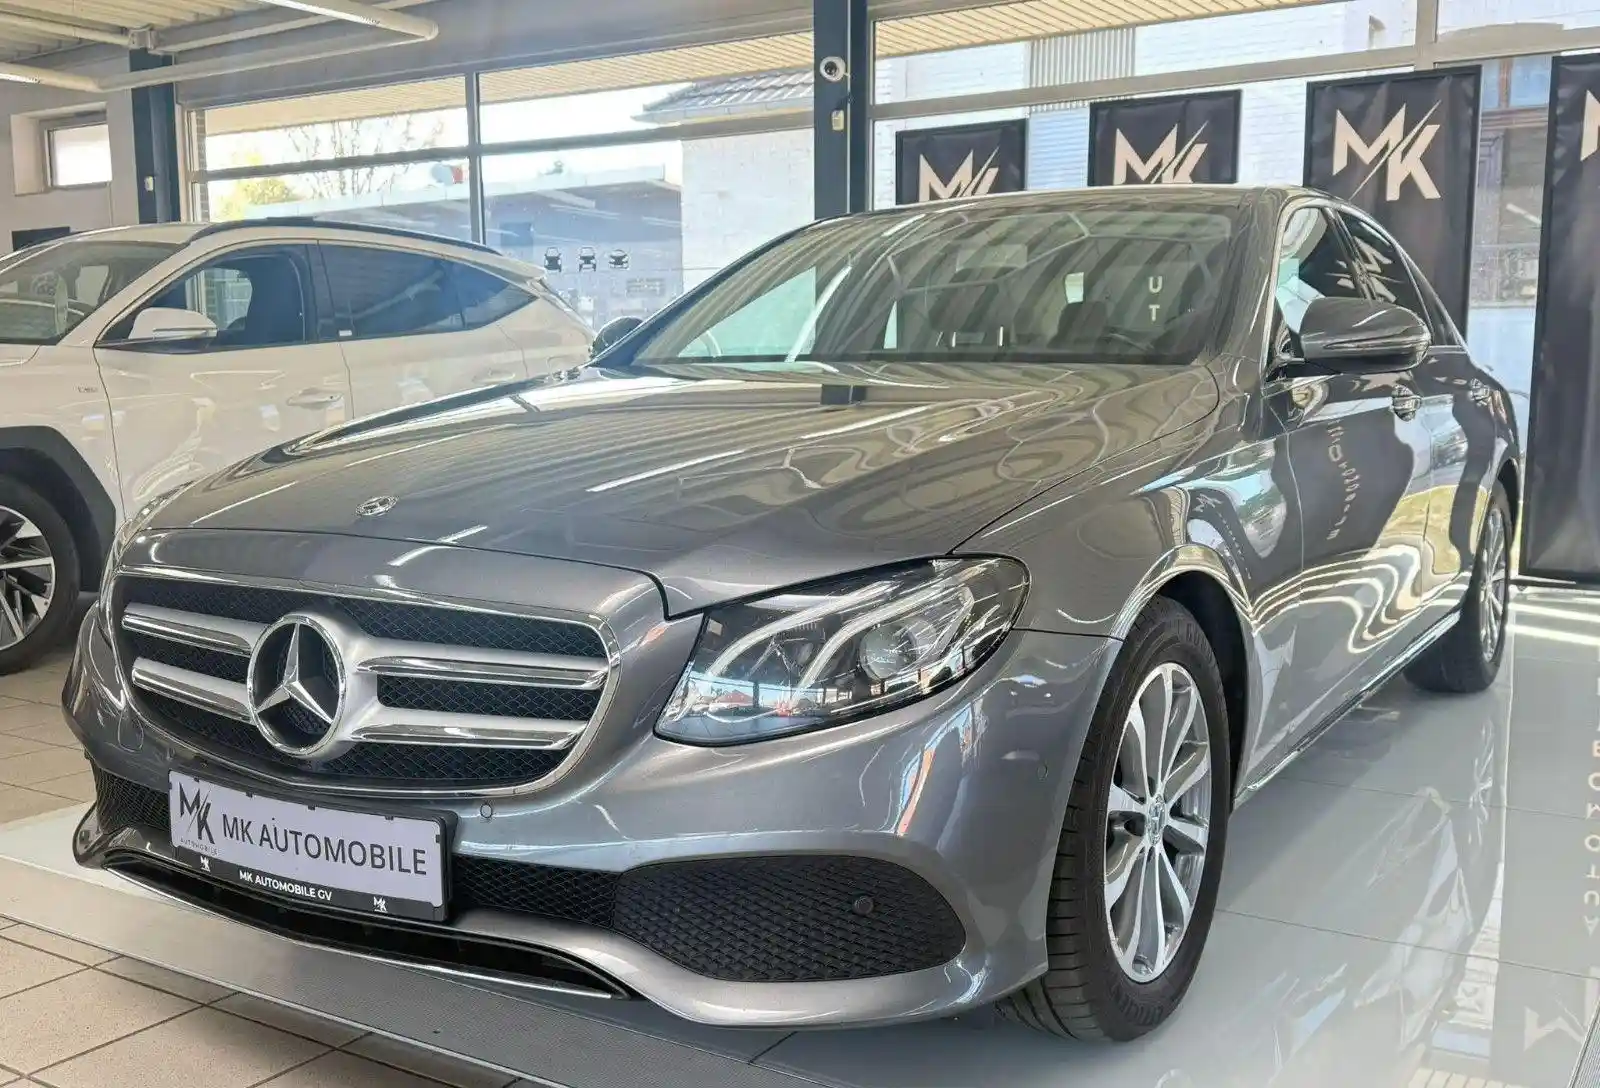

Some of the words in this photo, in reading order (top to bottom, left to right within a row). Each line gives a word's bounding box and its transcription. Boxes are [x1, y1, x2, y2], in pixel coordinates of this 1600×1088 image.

[1332, 100, 1441, 201] MK
[179, 781, 215, 845] MK
[222, 813, 254, 845] MK
[259, 824, 427, 876] AUTOMOBILE
[239, 870, 254, 883] MK
[254, 875, 315, 898] AUTOMOBILE
[317, 889, 332, 901] GV
